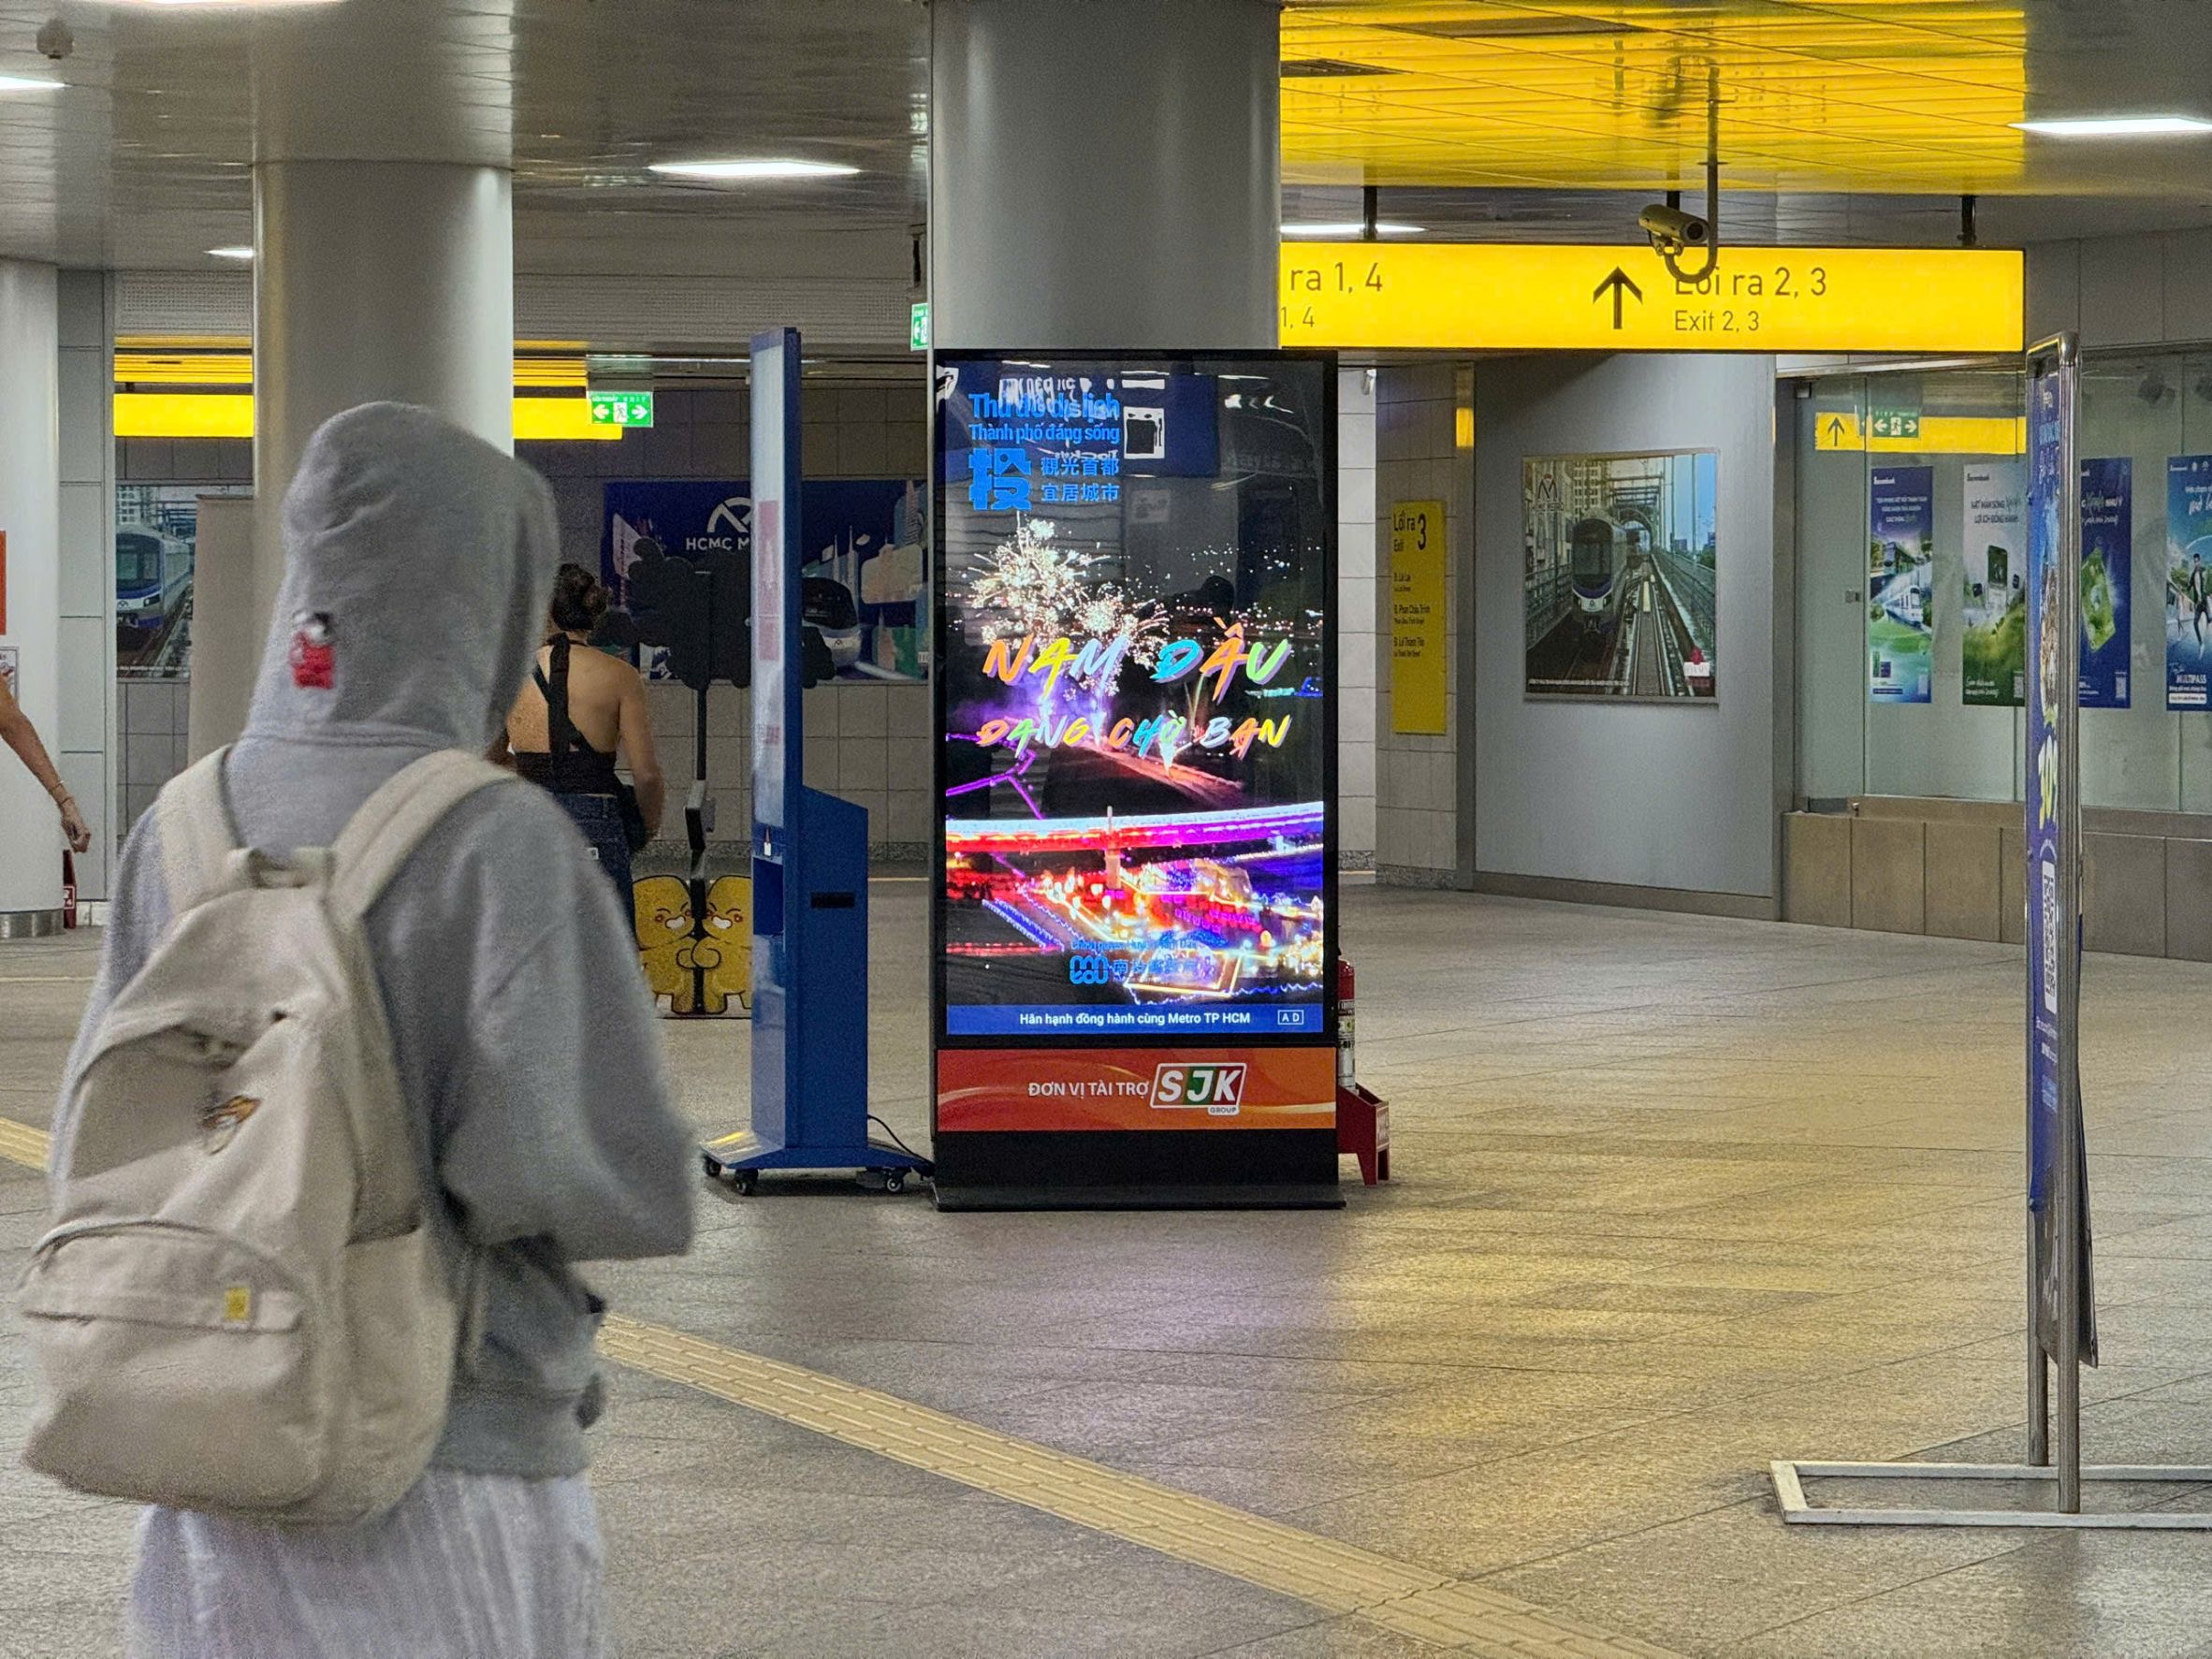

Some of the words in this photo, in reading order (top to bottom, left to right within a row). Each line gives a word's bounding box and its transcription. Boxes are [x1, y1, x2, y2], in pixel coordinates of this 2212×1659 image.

[1290, 269, 1321, 292] ra
[1364, 261, 1383, 292] 4
[1732, 273, 1763, 297] ra
[1774, 266, 1798, 298] 2,
[1811, 266, 1826, 297] 3
[1302, 306, 1316, 328] 4
[1675, 310, 1715, 331] Exit
[1722, 310, 1740, 333] 2,
[1747, 310, 1760, 332] 3
[968, 422, 1014, 441] Thành
[1015, 422, 1044, 444] phố
[1045, 422, 1083, 444] đáng
[1084, 422, 1121, 445] sống
[1041, 483, 1120, 502] 宜居城市
[685, 536, 733, 551] HCMC
[1417, 513, 1427, 551] 3
[982, 633, 1129, 700] NAM
[1045, 1013, 1072, 1026] hạnh
[1107, 1012, 1135, 1025] hành
[1137, 1012, 1165, 1026] cùng
[1168, 1012, 1201, 1025] Metro
[1203, 1012, 1220, 1024] TP
[1222, 1012, 1250, 1024] HCM
[1028, 1080, 1066, 1097] ĐƠN
[1070, 1082, 1084, 1100] VỊ
[1088, 1079, 1113, 1097] TÀI
[1115, 1080, 1150, 1099] TRỢ
[1157, 1070, 1242, 1102] SJK
[1209, 1106, 1237, 1114] GROUP
